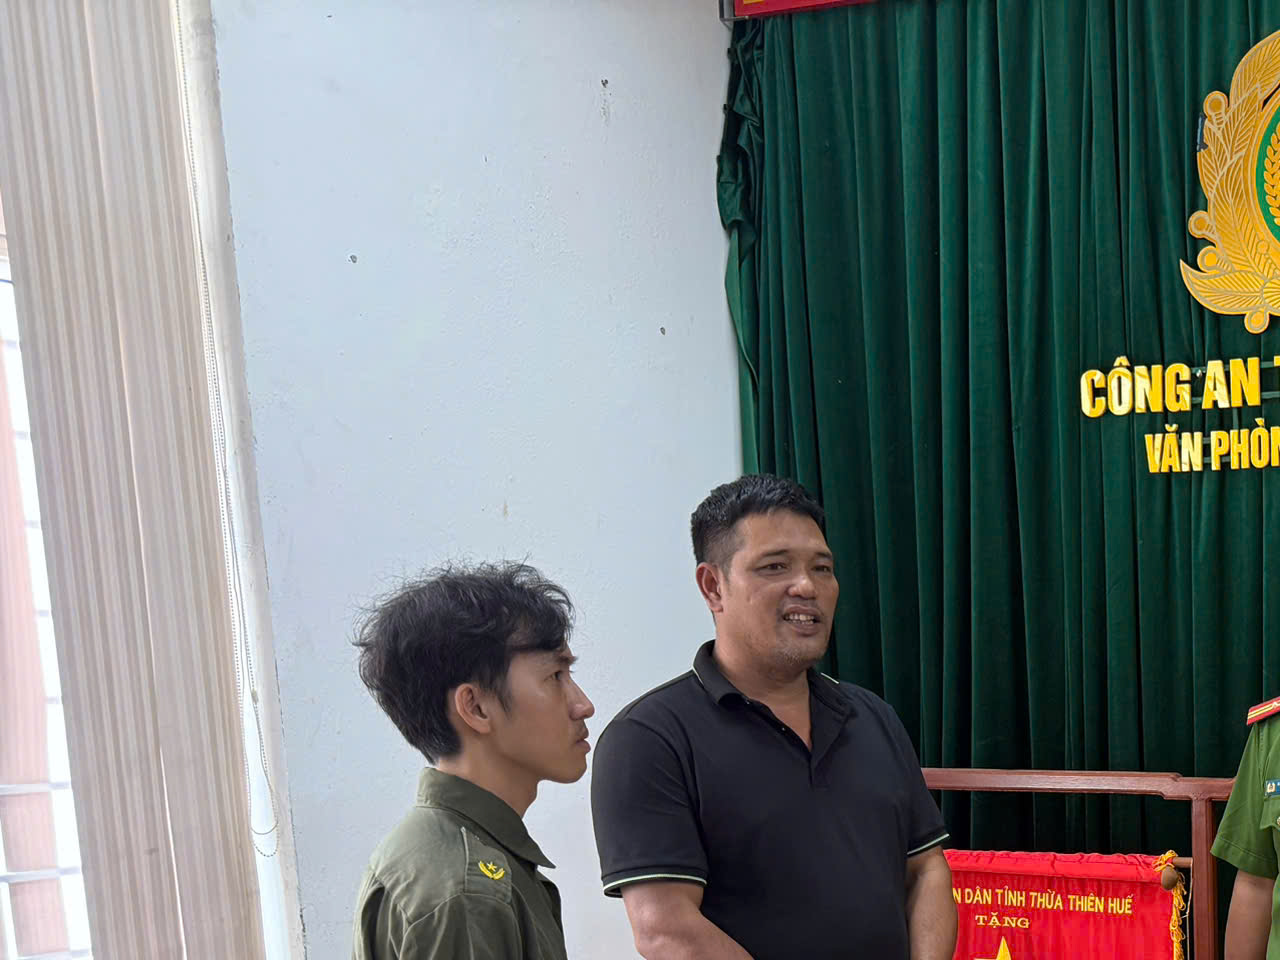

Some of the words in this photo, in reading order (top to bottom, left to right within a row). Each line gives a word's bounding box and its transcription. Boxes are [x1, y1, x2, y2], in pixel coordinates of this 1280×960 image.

[1080, 355, 1192, 418] CÔNG
[1201, 356, 1261, 410] AN
[1144, 423, 1204, 473] VĂN
[964, 885, 992, 905] DÂN
[994, 885, 1026, 907] TỈNH
[1029, 888, 1063, 910] THỪA
[1067, 892, 1105, 913] THIÊN
[1108, 893, 1134, 915] HUẾ
[975, 911, 1030, 929] TẶNG
